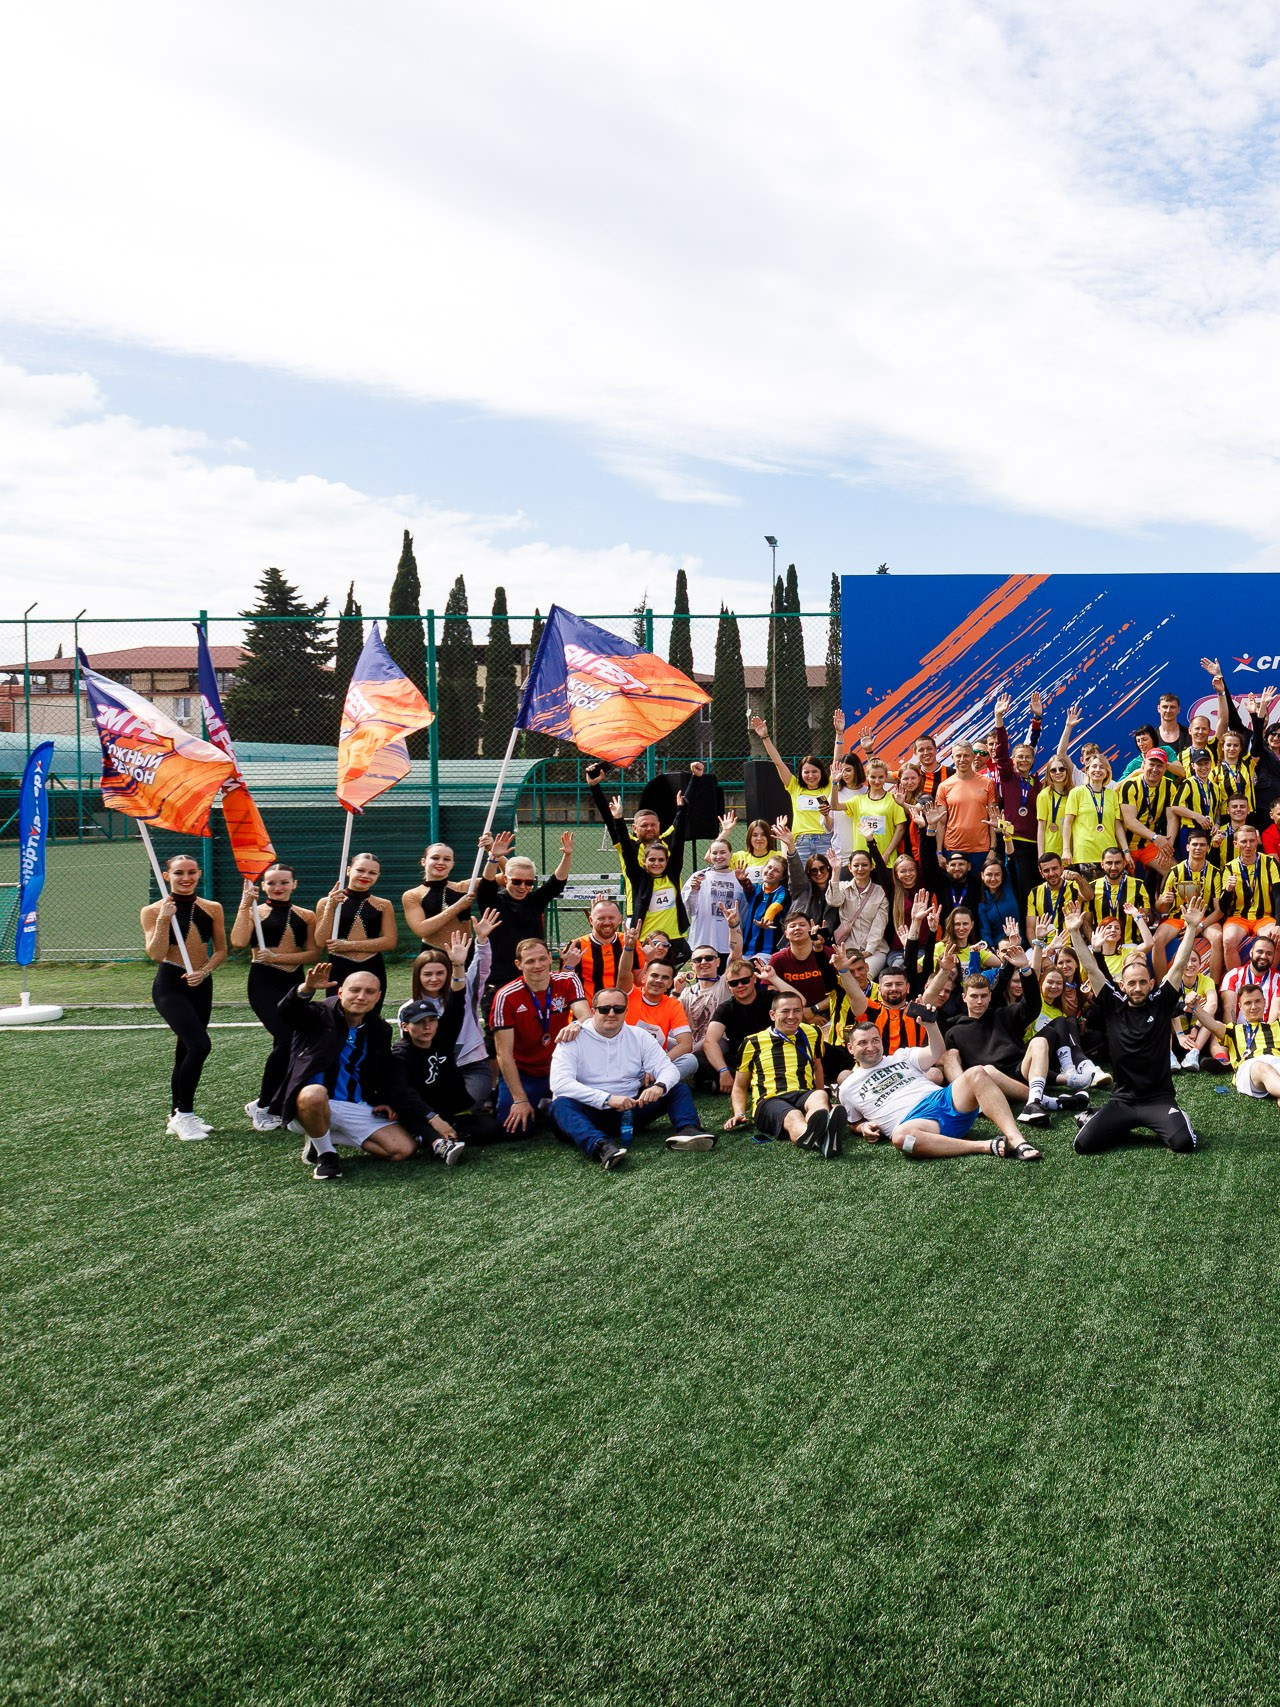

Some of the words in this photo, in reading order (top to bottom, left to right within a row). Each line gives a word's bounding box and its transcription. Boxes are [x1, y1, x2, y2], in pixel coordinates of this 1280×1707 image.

[566, 677, 612, 702] ЖНЫЙ
[585, 658, 651, 693] FEST
[656, 896, 669, 905] 44
[859, 1061, 910, 1101] AUTHENTIC
